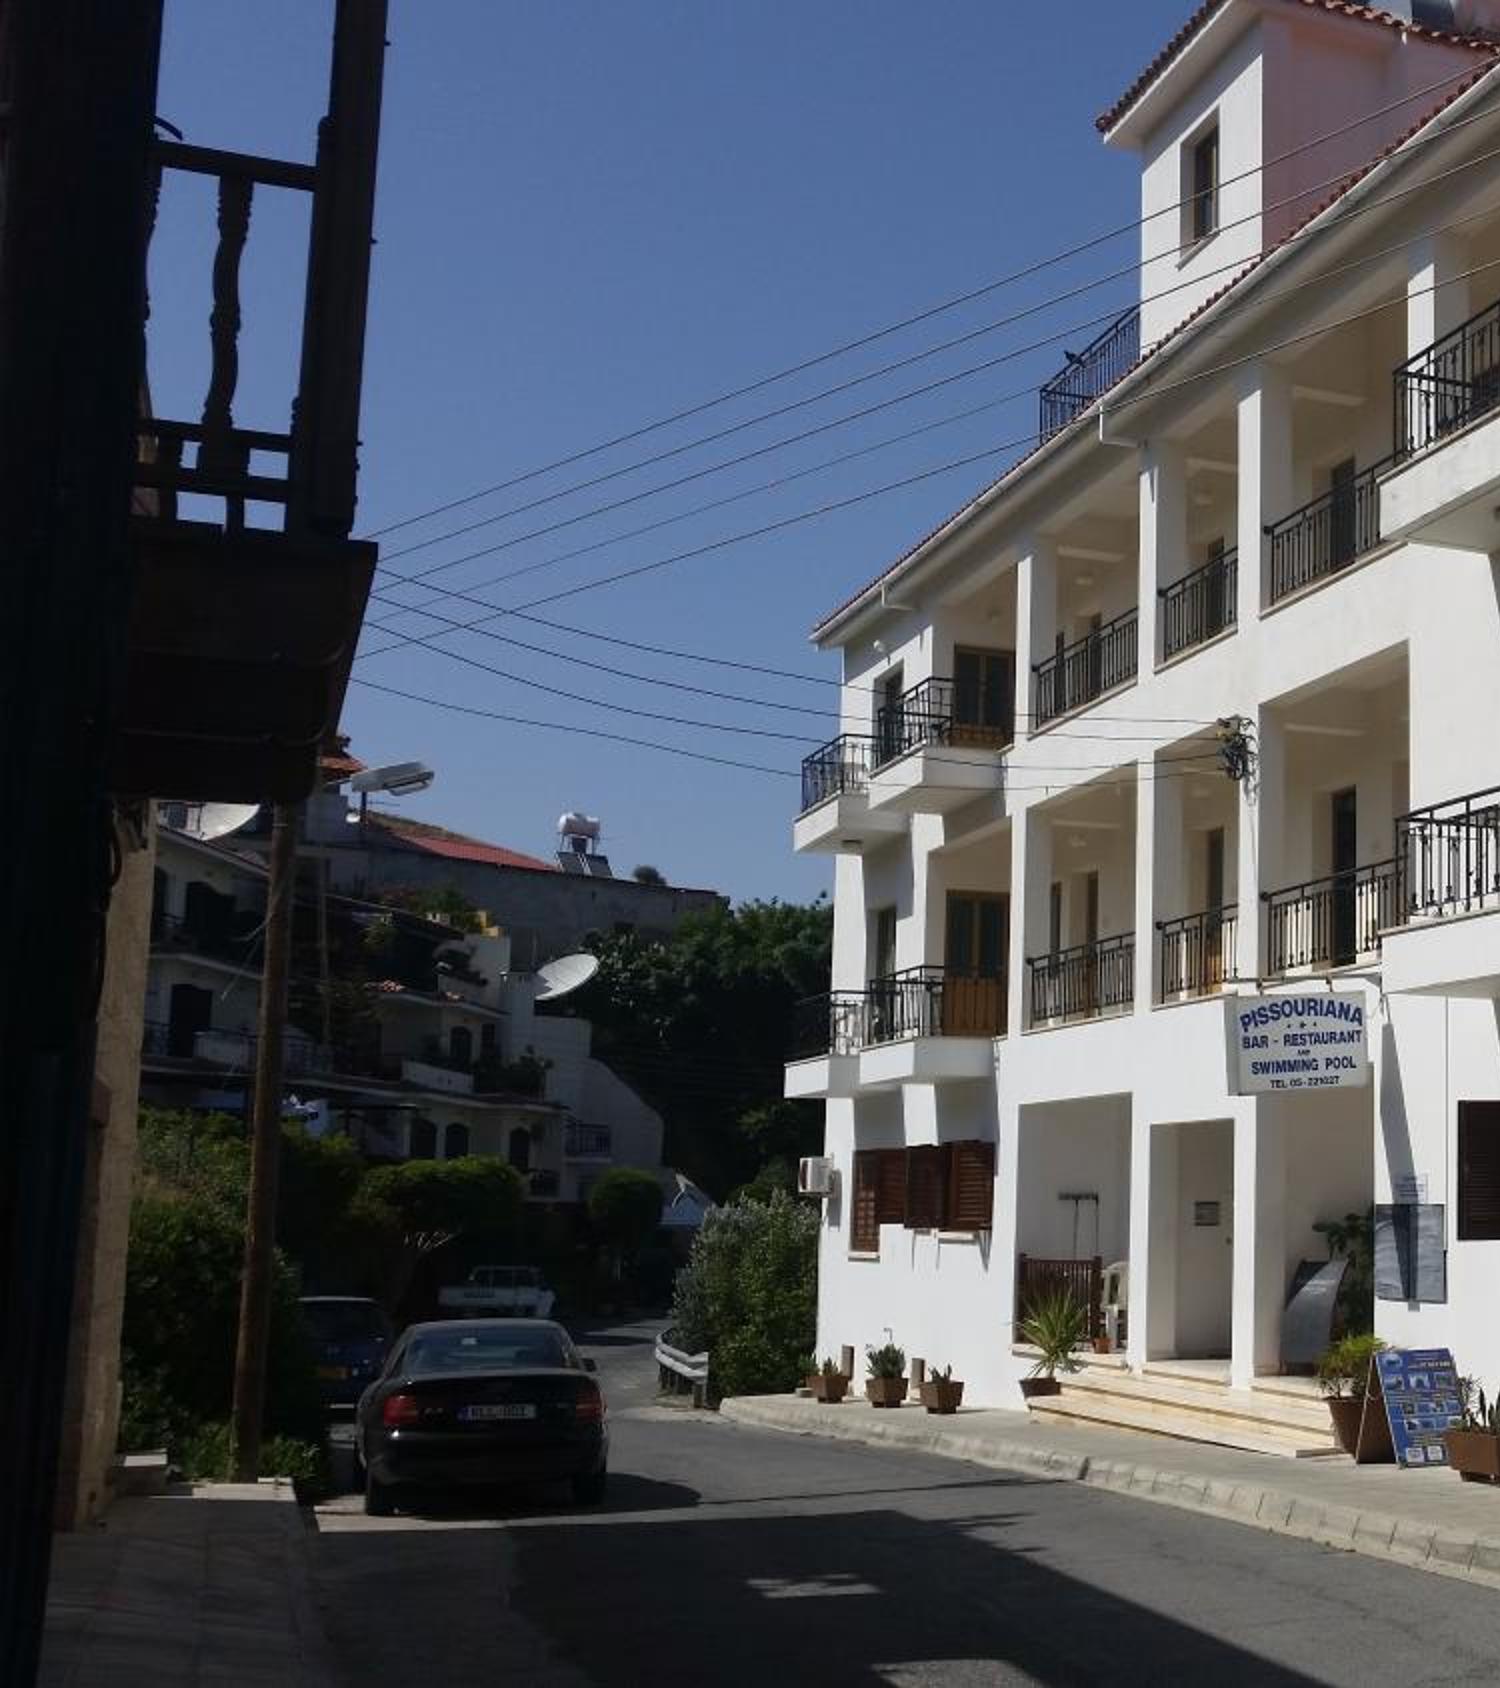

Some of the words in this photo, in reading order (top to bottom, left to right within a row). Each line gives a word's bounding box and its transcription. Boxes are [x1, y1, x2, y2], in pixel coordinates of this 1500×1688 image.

[1240, 998, 1363, 1032] PISSOURIANA
[1242, 1036, 1269, 1049] BAR
[1284, 1030, 1362, 1046] RESTAURANT
[1251, 1058, 1319, 1075] SWIMMING
[1325, 1056, 1357, 1070] POOL
